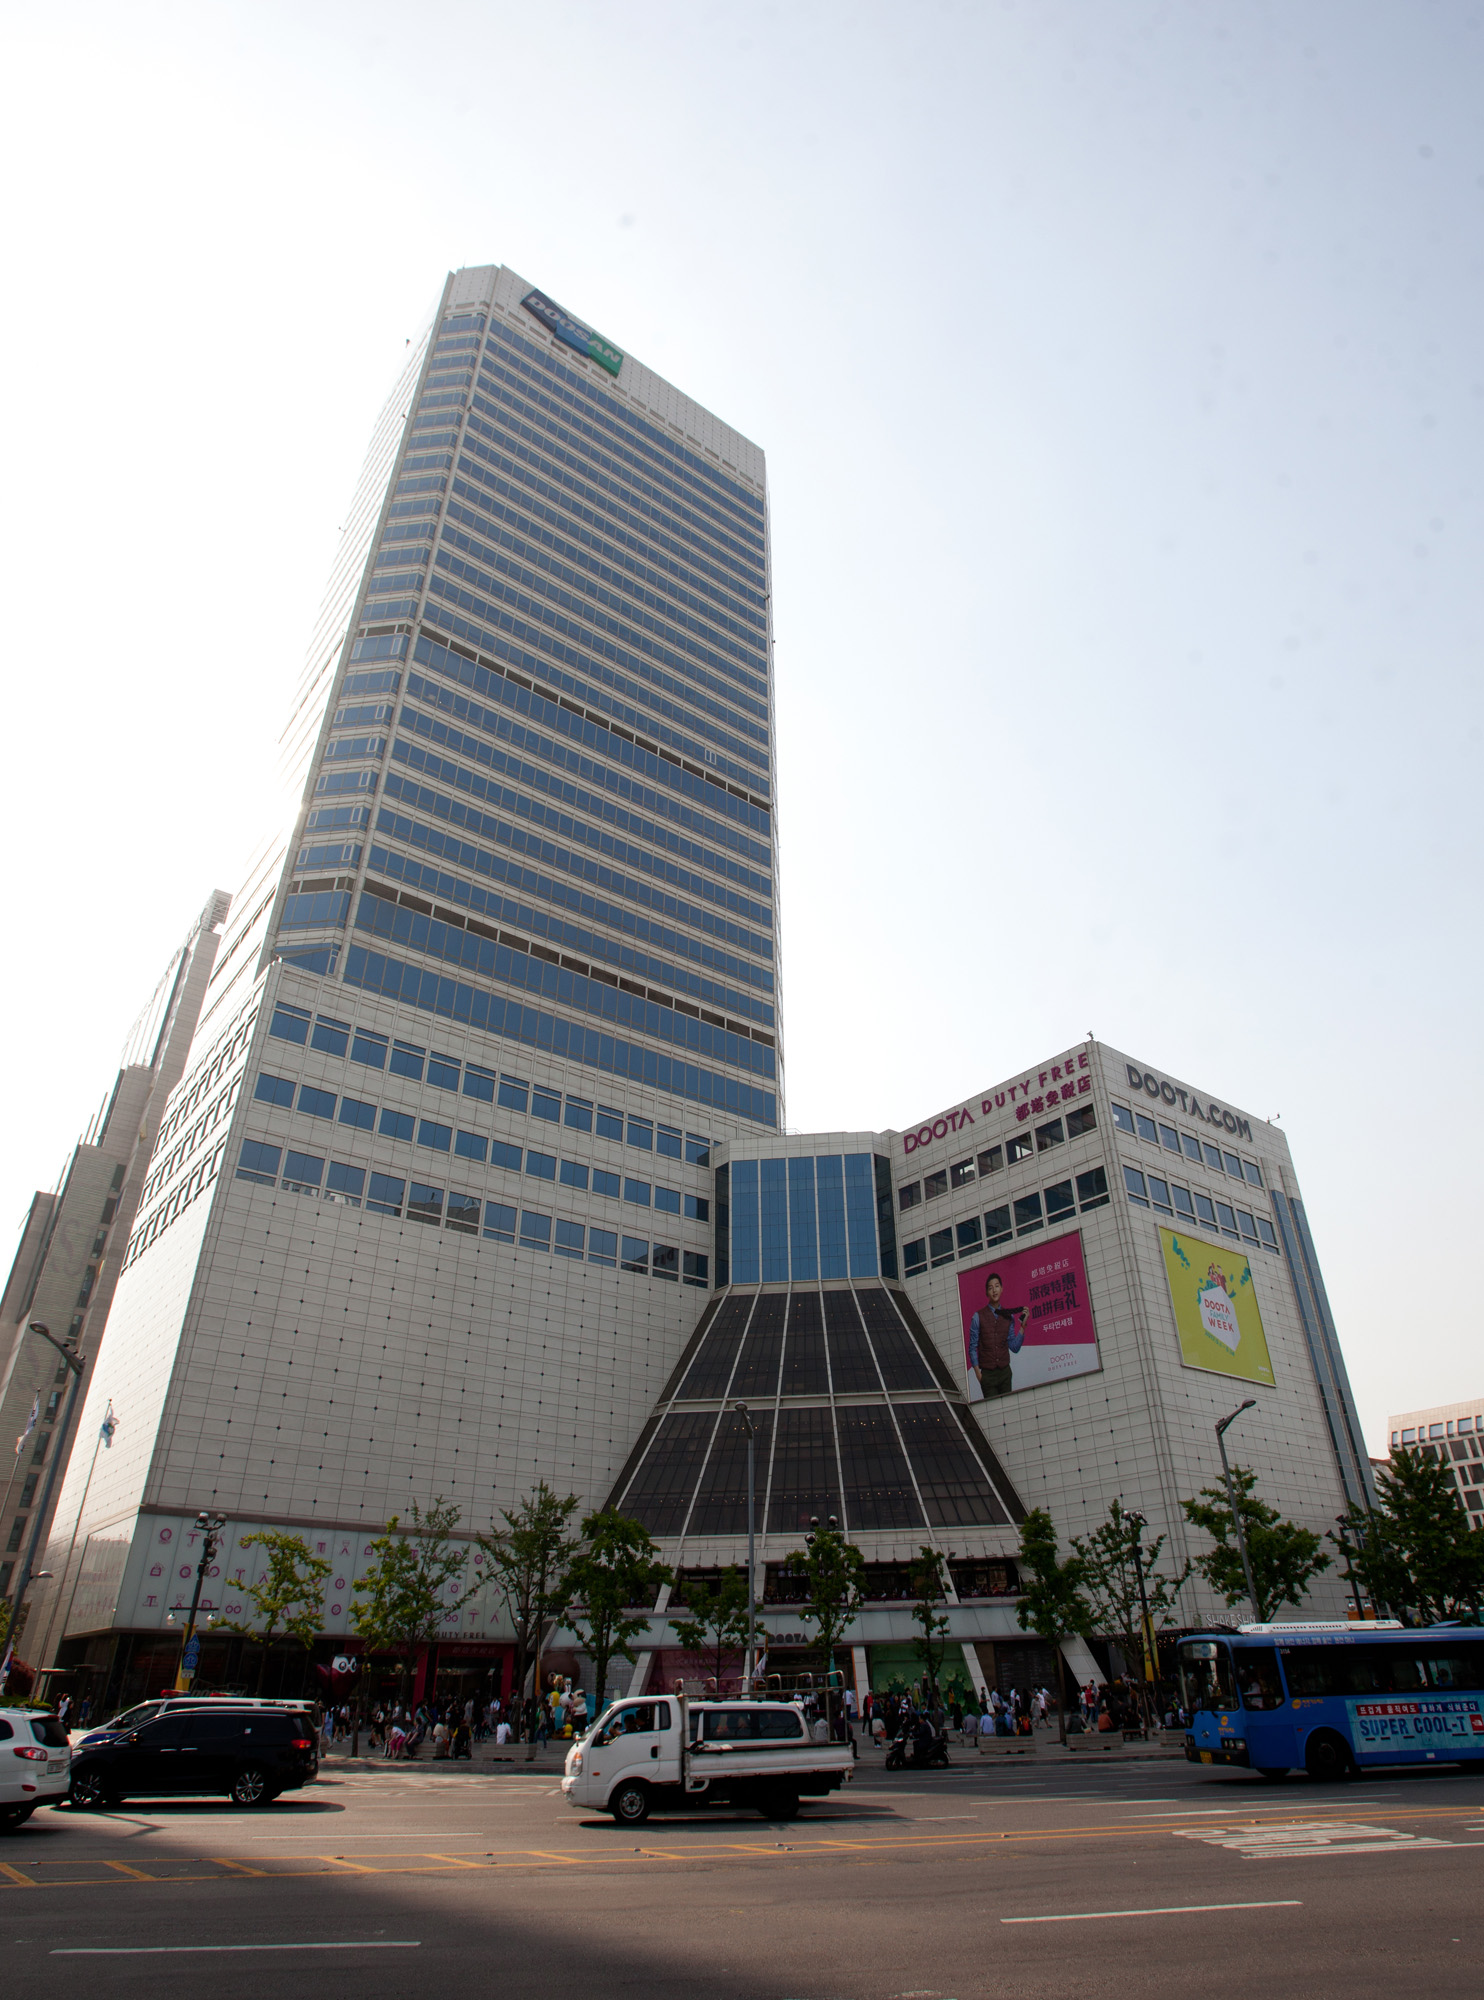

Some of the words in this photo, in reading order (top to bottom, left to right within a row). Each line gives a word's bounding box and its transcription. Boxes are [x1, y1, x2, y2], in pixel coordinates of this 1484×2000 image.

[527, 296, 621, 363] DOOSAN
[903, 1107, 975, 1154] DOOTA
[981, 1079, 1031, 1115] DUTY
[1038, 1052, 1089, 1087] FREE
[1126, 1063, 1253, 1142] DOOTA.COM
[1029, 1271, 1077, 1302] 深夜特惠
[1204, 1298, 1231, 1315] DOOTA
[1209, 1309, 1229, 1321] FAMILY
[1042, 1317, 1073, 1332] 두타면세점
[1208, 1317, 1234, 1333] WEEK
[1050, 1352, 1074, 1364] DOOTA
[1206, 1613, 1237, 1627] SHAKE
[767, 1633, 808, 1643] DOOTA
[1359, 1705, 1382, 1715] 뜨겁게
[1386, 1704, 1417, 1714] 움직여도
[1359, 1717, 1409, 1736] SUPER
[1414, 1716, 1466, 1734] COOL-T
